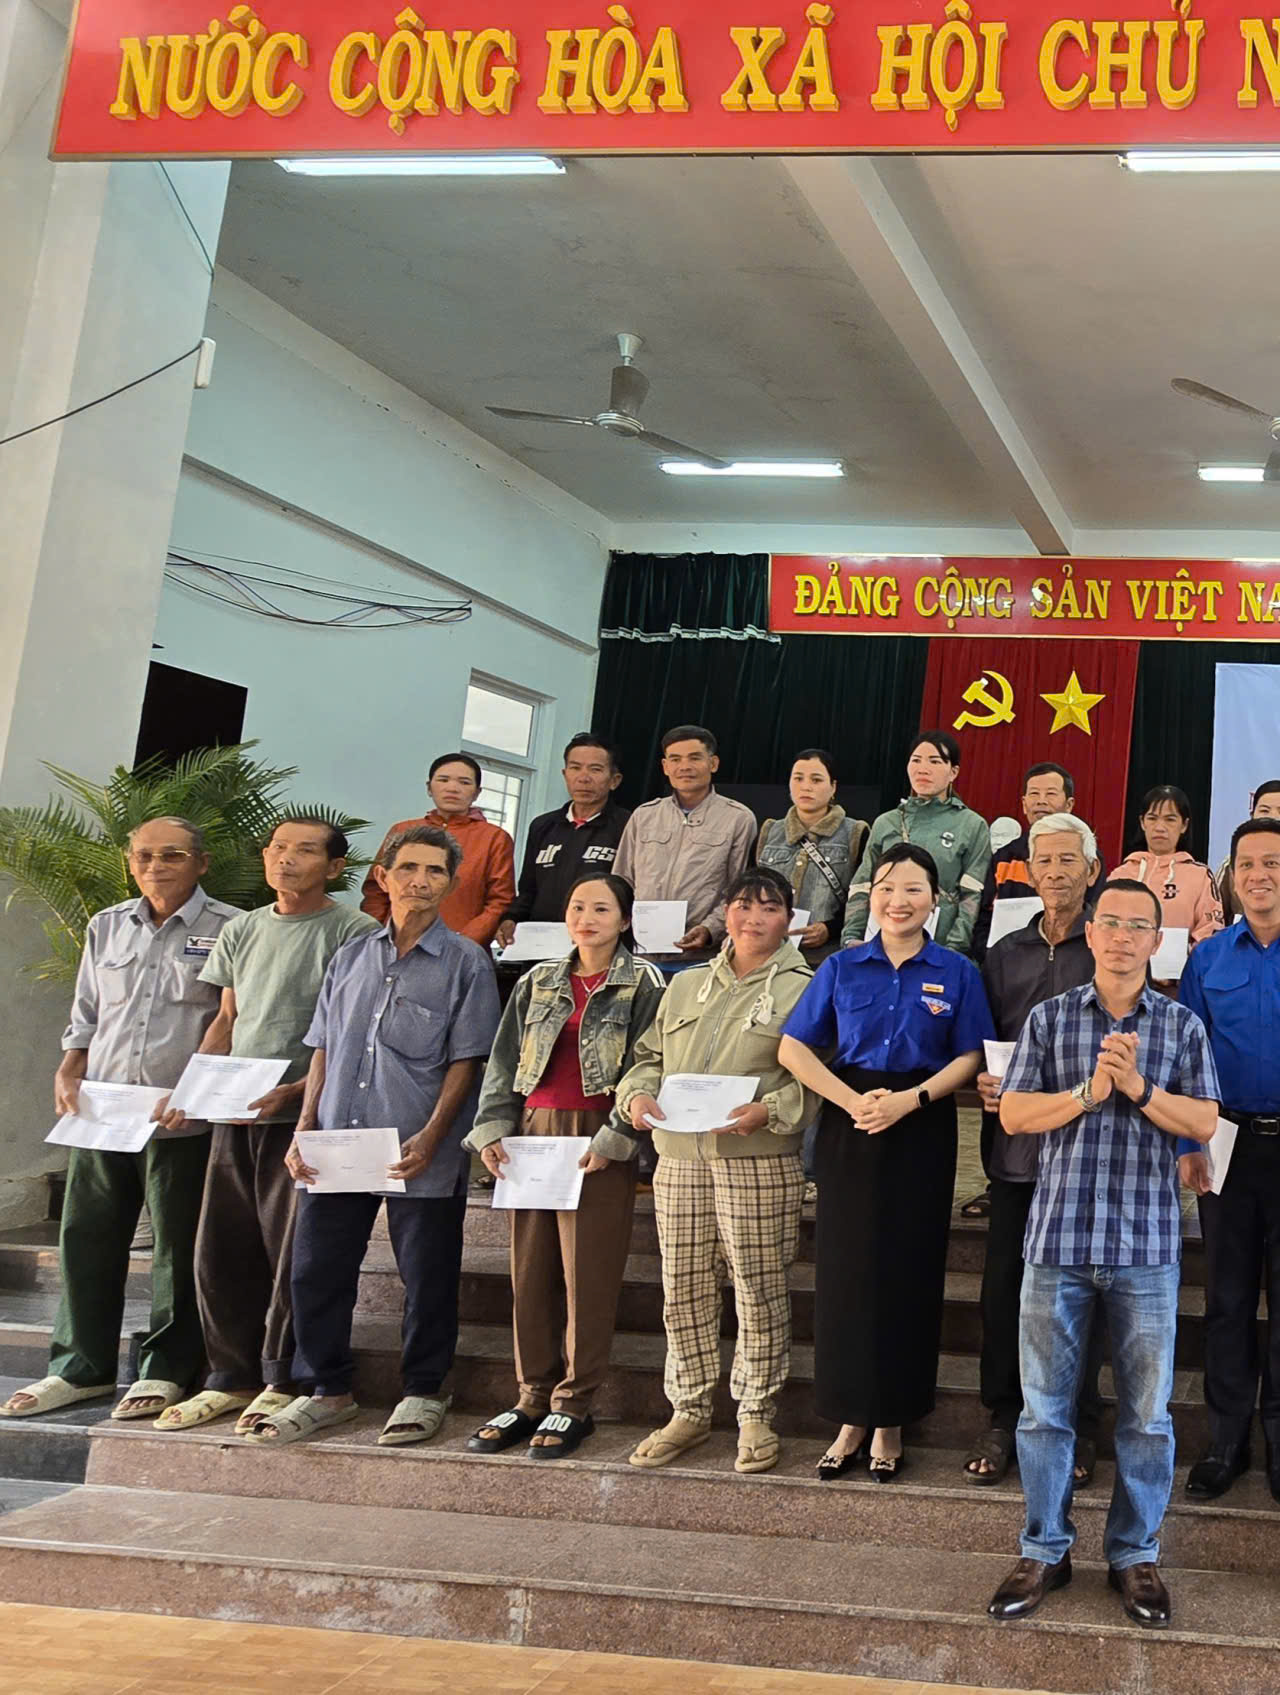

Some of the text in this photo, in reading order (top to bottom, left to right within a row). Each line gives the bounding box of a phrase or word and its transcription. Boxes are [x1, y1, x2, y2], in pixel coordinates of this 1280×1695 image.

[331, 8, 520, 134] CỘNG
[537, 4, 689, 113] HÒA
[721, 2, 841, 113] XÃ
[872, 0, 1008, 131] HỘI
[1038, 0, 1206, 111] CHỦ
[793, 561, 900, 617] ĐẢNG
[914, 565, 1014, 630] CỘNG
[1029, 564, 1112, 621] SẢN
[1125, 568, 1225, 633] VIỆT
